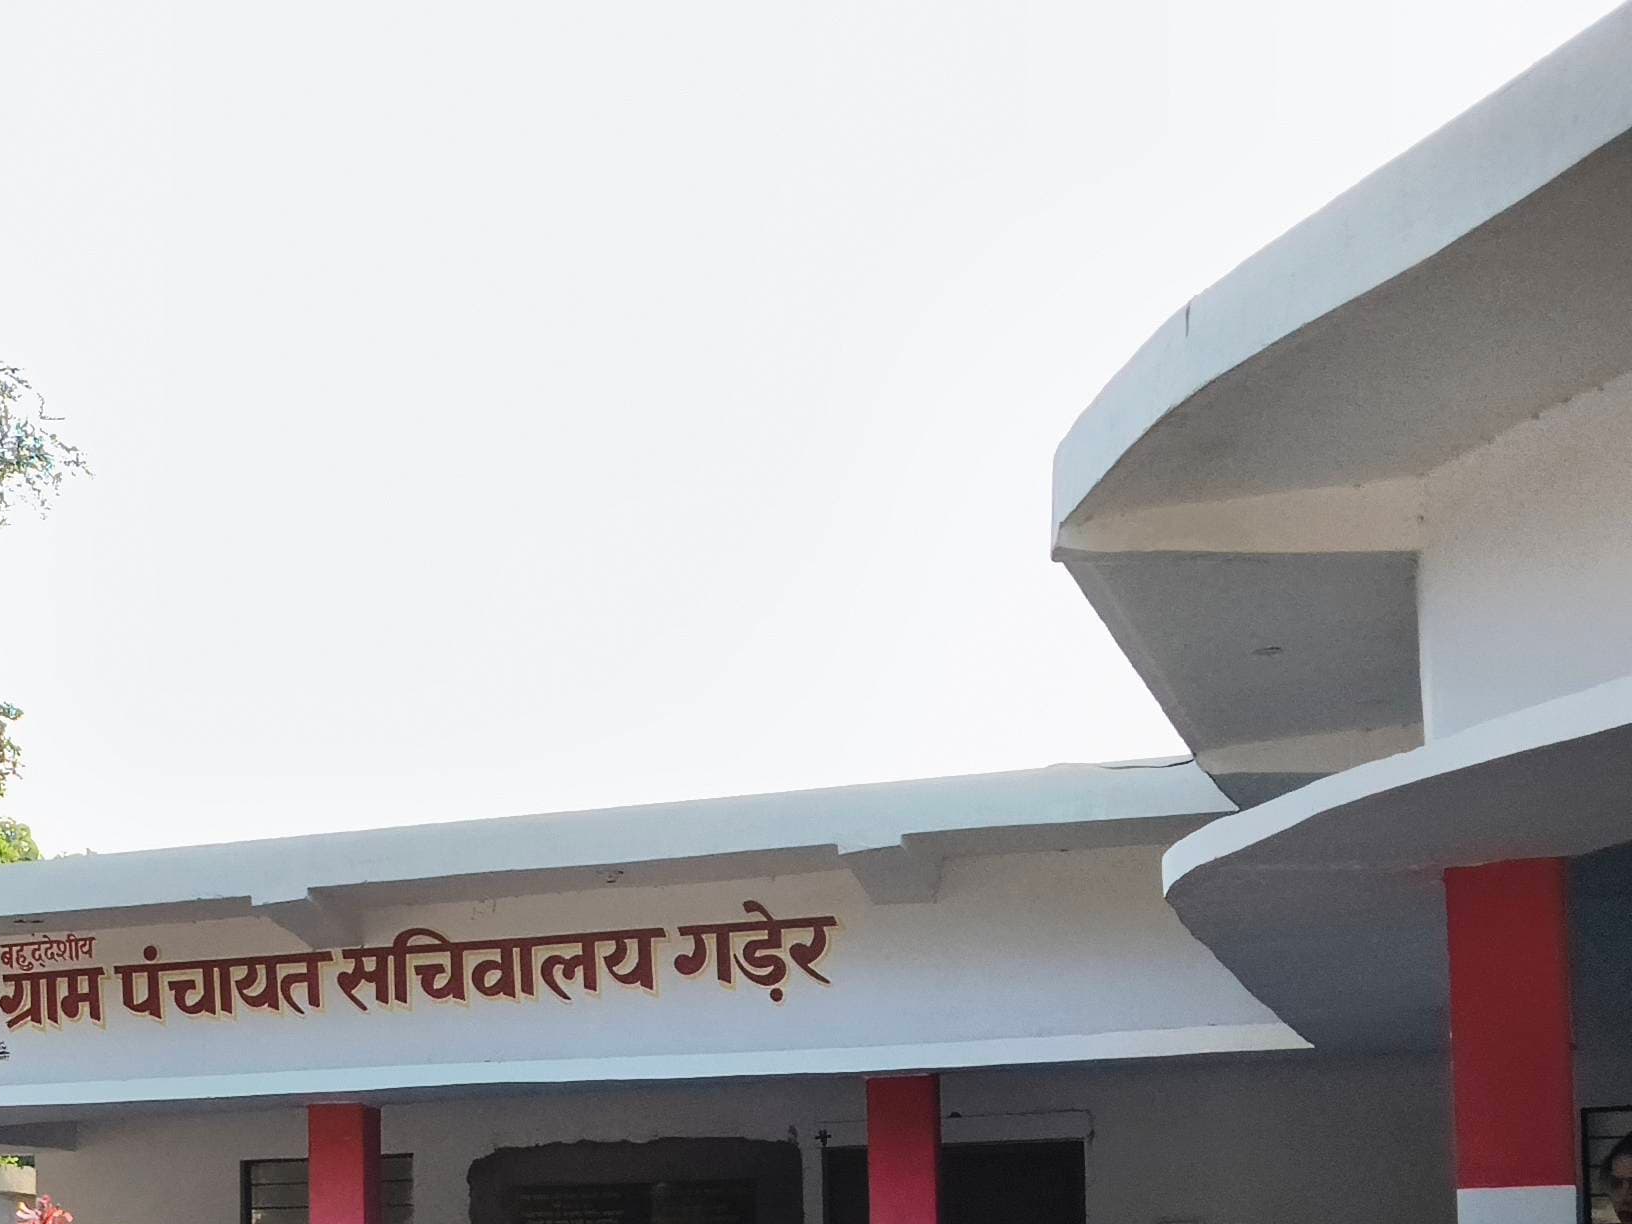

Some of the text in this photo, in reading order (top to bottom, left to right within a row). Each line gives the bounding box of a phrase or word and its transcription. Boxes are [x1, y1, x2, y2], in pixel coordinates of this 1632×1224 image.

[0, 900, 837, 1028] ग्राम पंचायत सचिवालय गड़ेर
